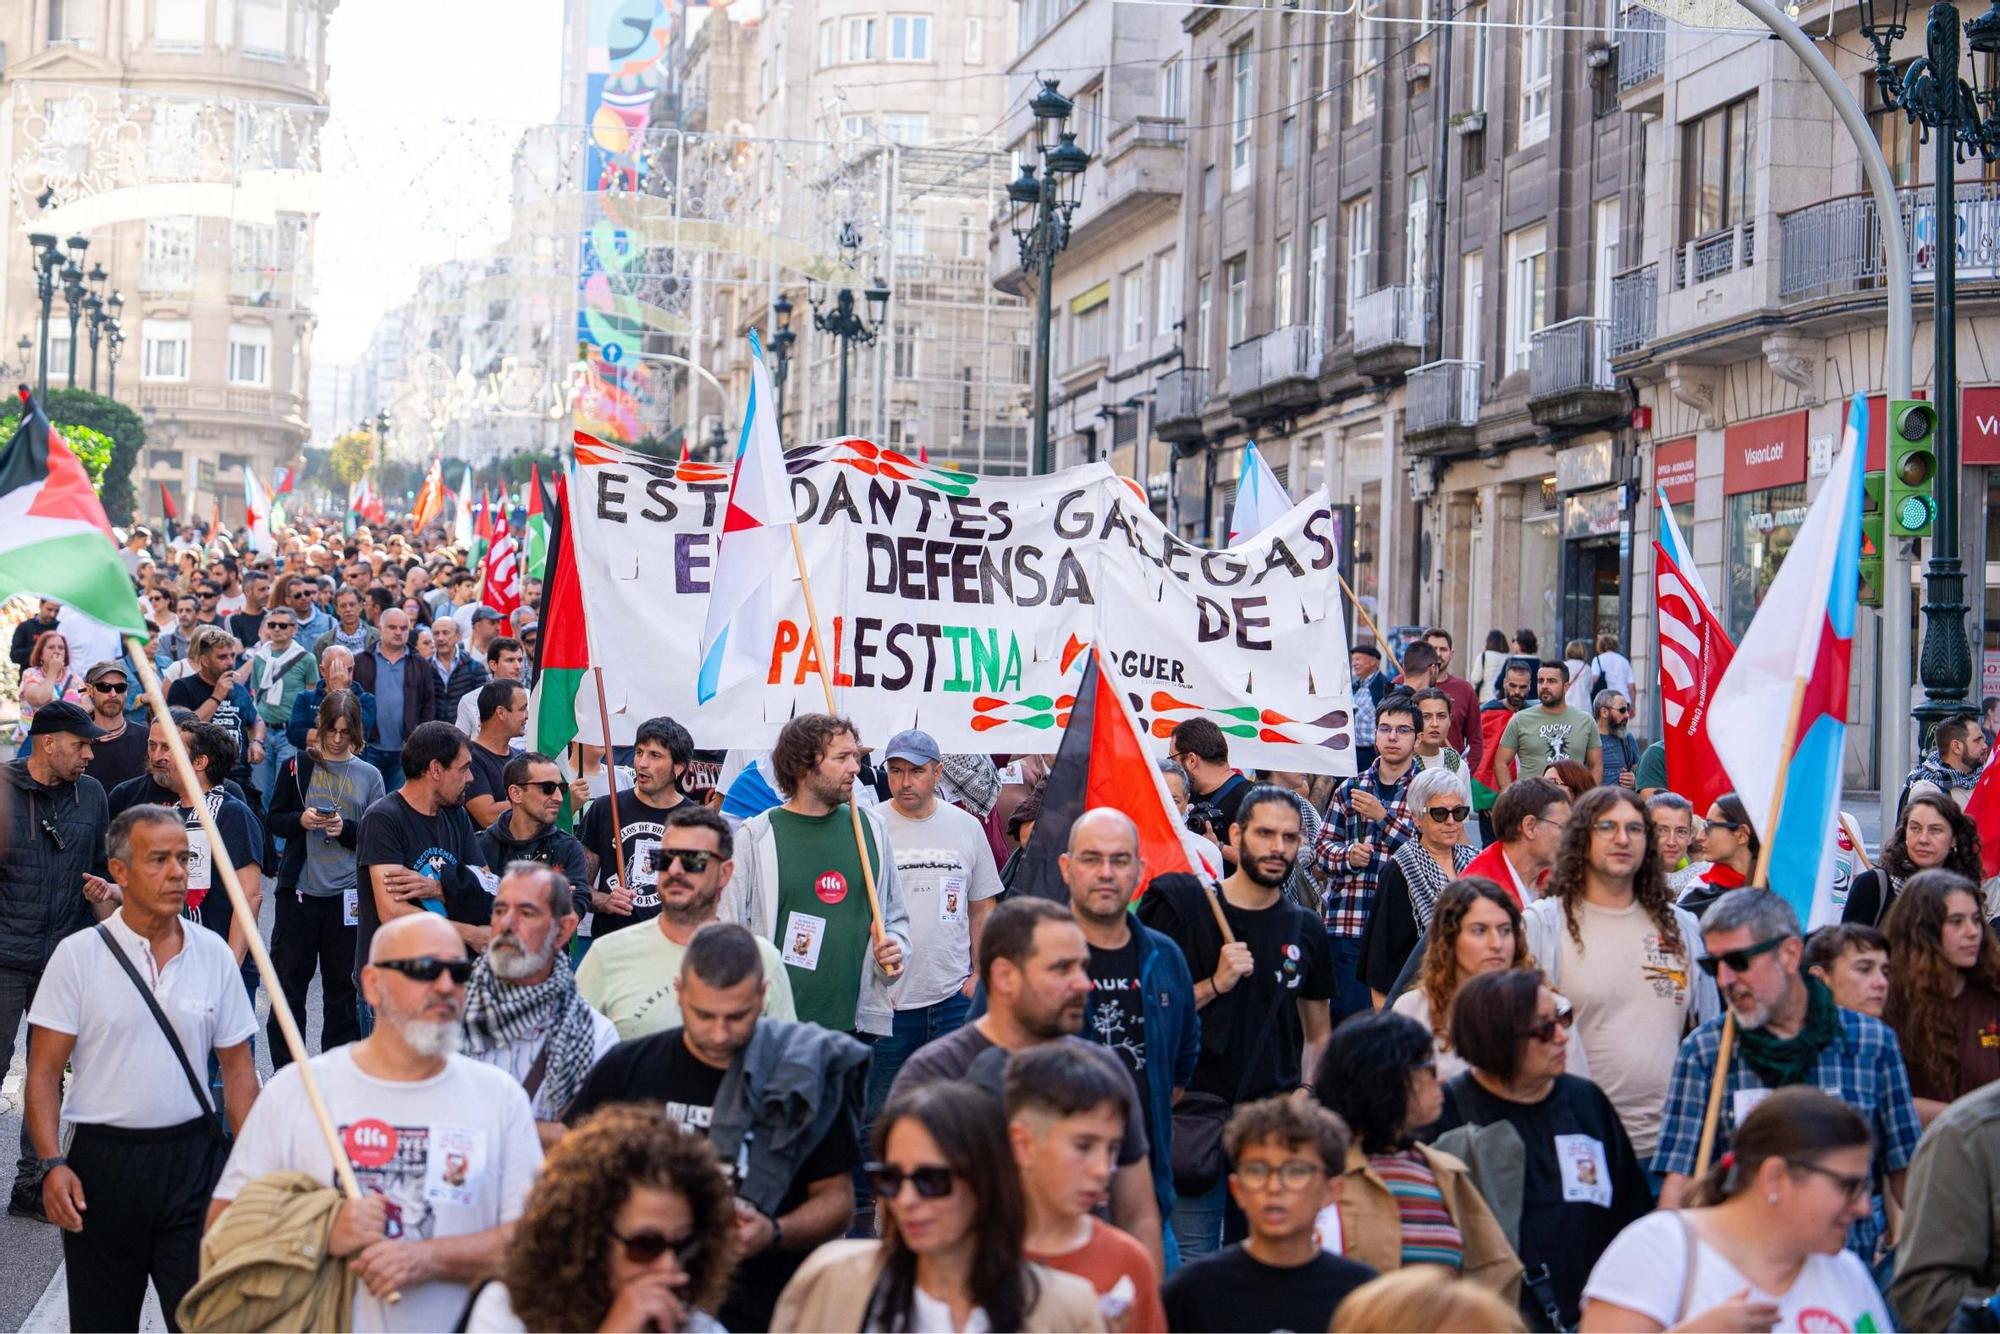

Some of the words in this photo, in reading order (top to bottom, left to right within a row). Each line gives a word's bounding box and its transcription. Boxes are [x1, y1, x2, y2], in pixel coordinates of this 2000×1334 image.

[598, 470, 1013, 541] ESTDANTES
[675, 533, 722, 595] E
[866, 531, 1096, 608] DEFENSA
[767, 616, 1023, 693] PALESTINA
[1196, 593, 1273, 652] DE
[1540, 724, 1571, 734] OUCH!
[638, 824, 651, 832] DE
